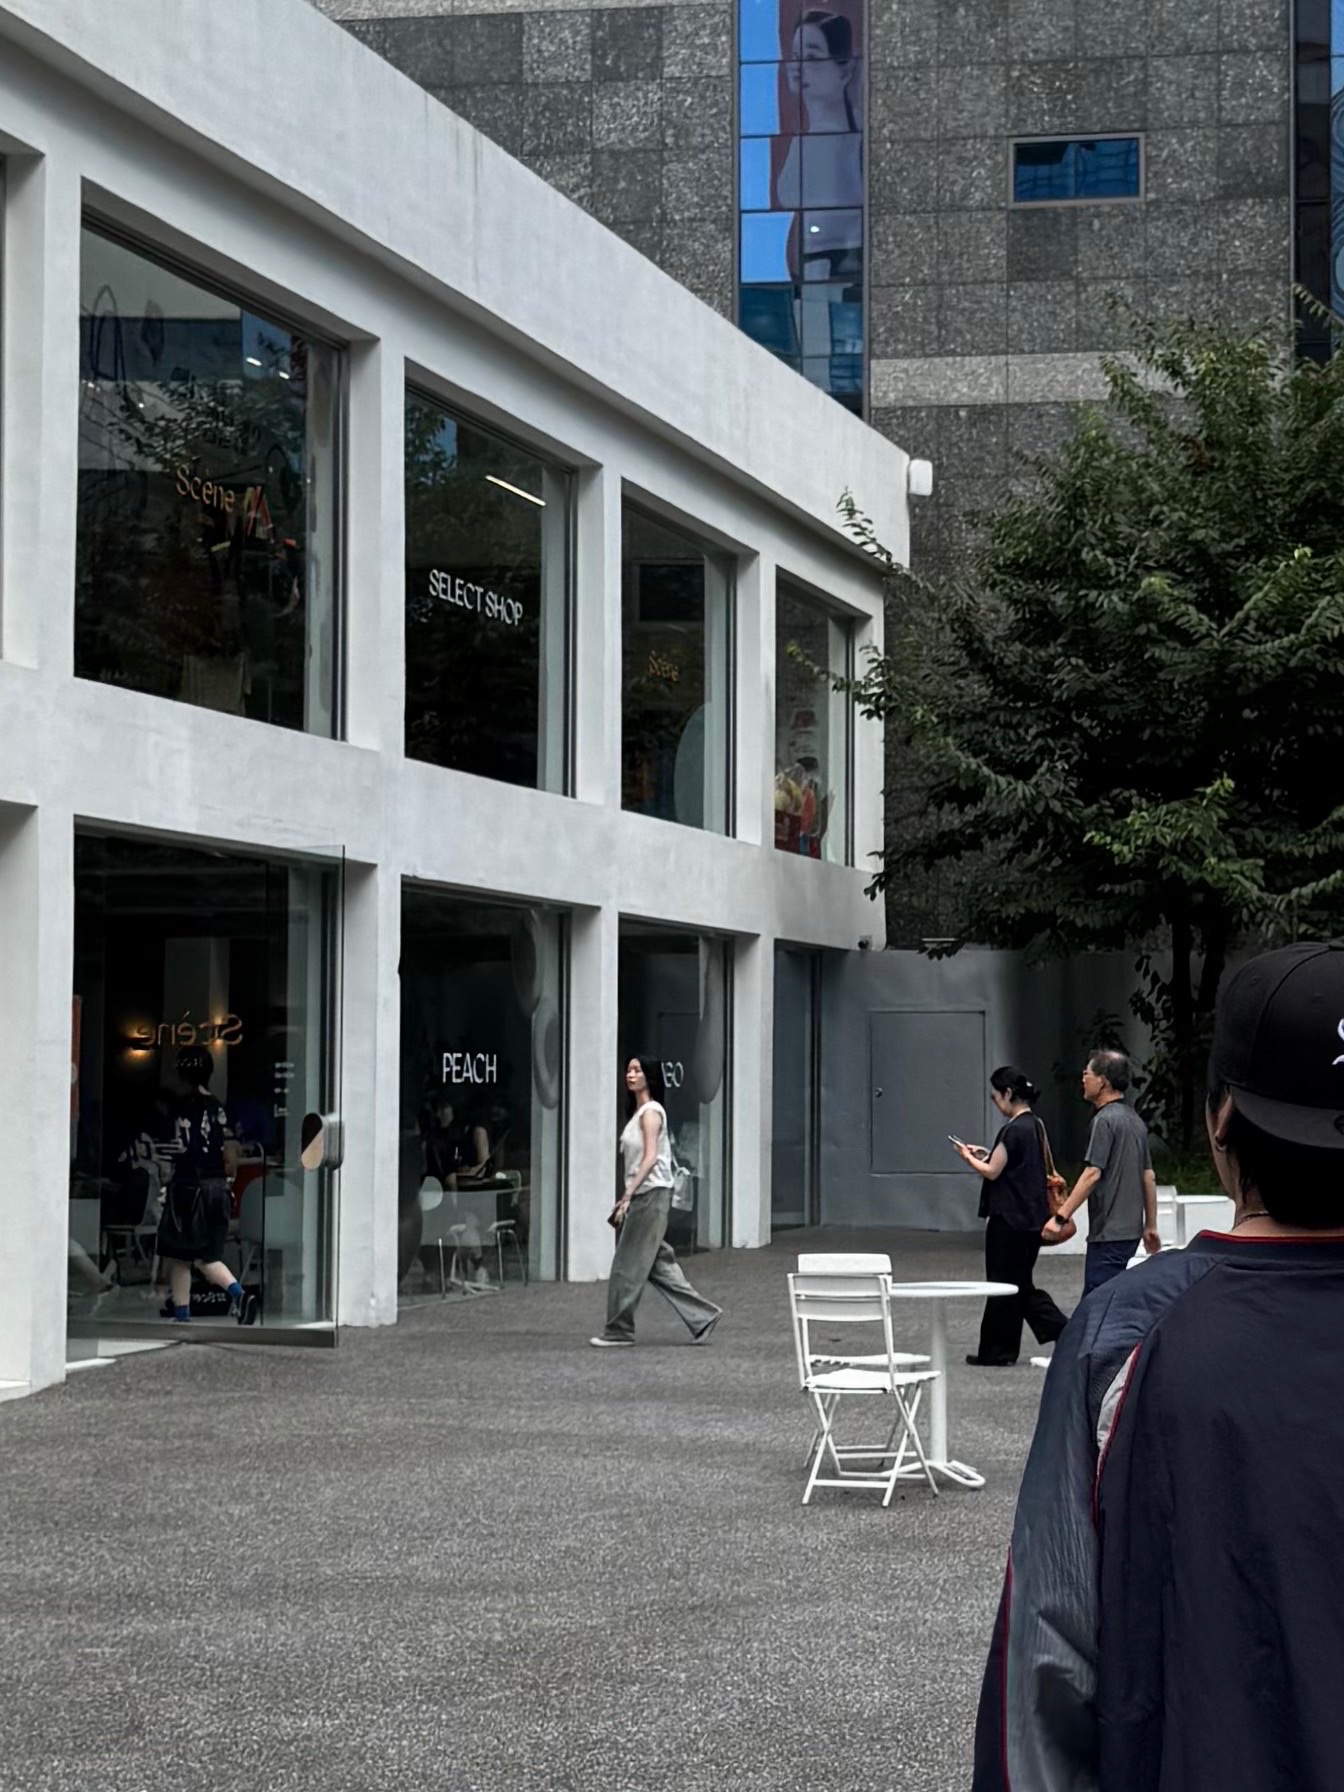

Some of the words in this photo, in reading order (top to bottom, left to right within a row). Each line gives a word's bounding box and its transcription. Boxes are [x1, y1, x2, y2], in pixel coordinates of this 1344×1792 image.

[428, 568, 484, 613] SELECT
[485, 590, 524, 627] SHOP
[442, 1052, 497, 1084] PEACH
